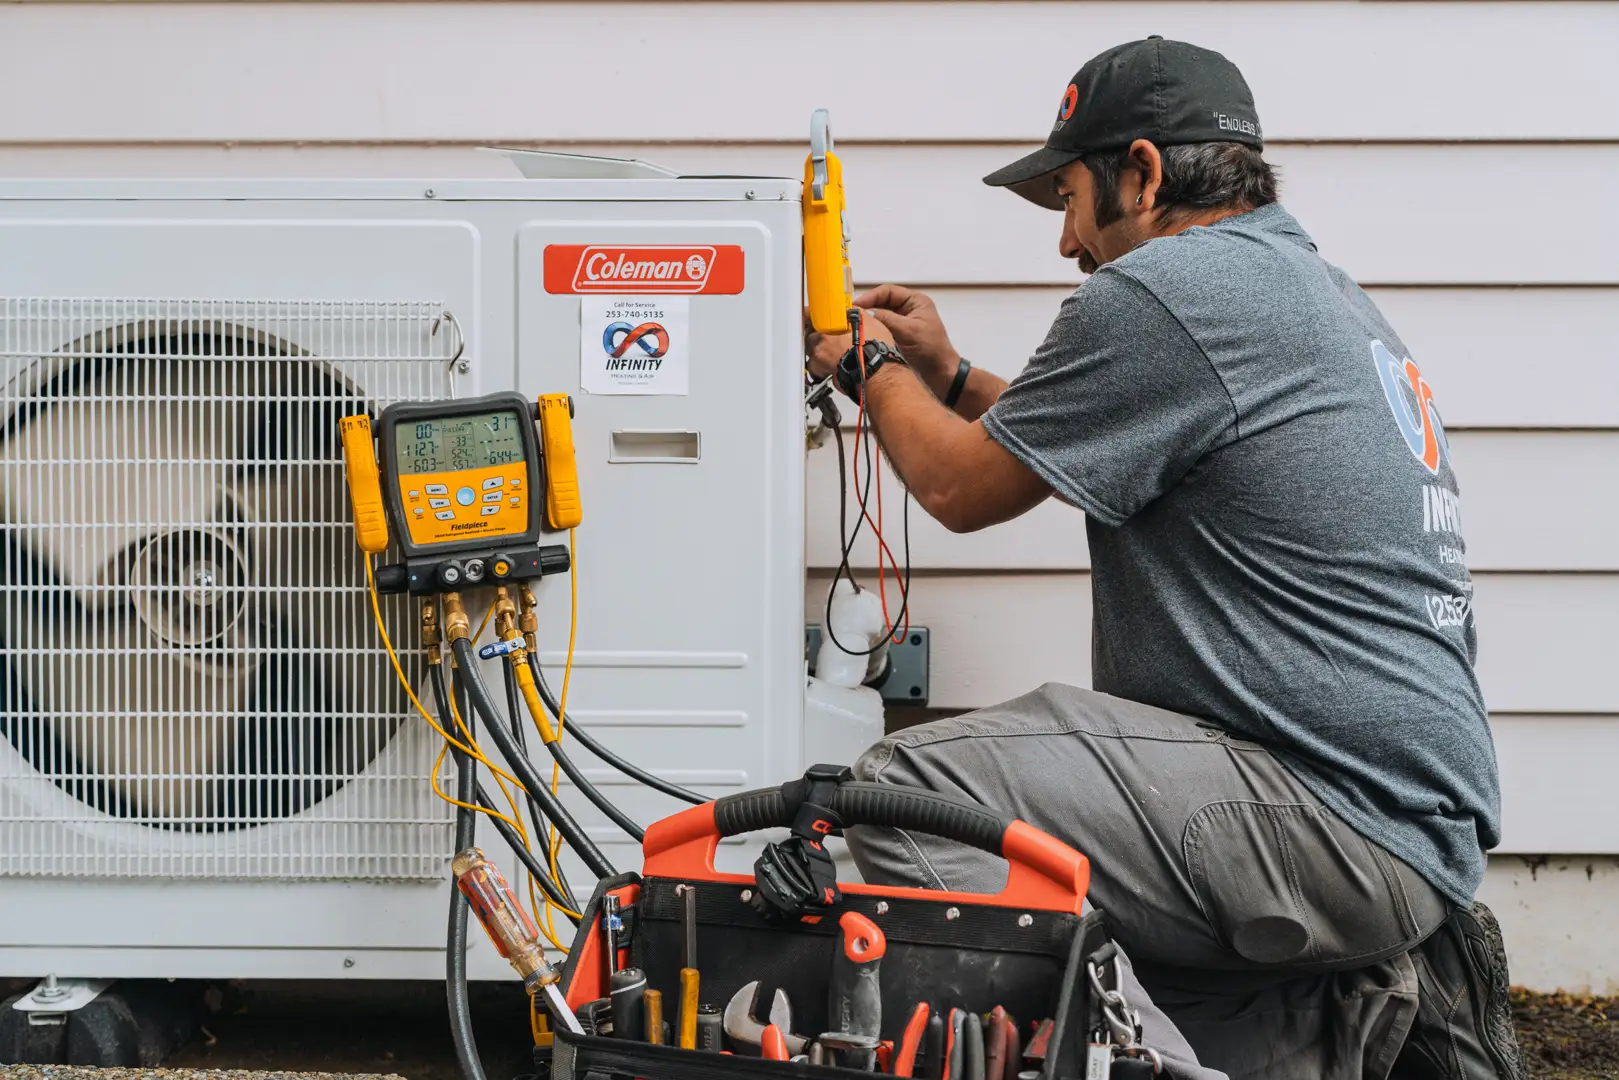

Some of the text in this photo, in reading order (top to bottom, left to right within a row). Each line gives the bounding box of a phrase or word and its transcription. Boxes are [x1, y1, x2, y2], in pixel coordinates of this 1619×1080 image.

[585, 252, 683, 281] Coleman
[605, 310, 664, 319] 253-740-5135
[605, 359, 663, 371] INFINITY
[450, 521, 488, 531] Fieldpiece
